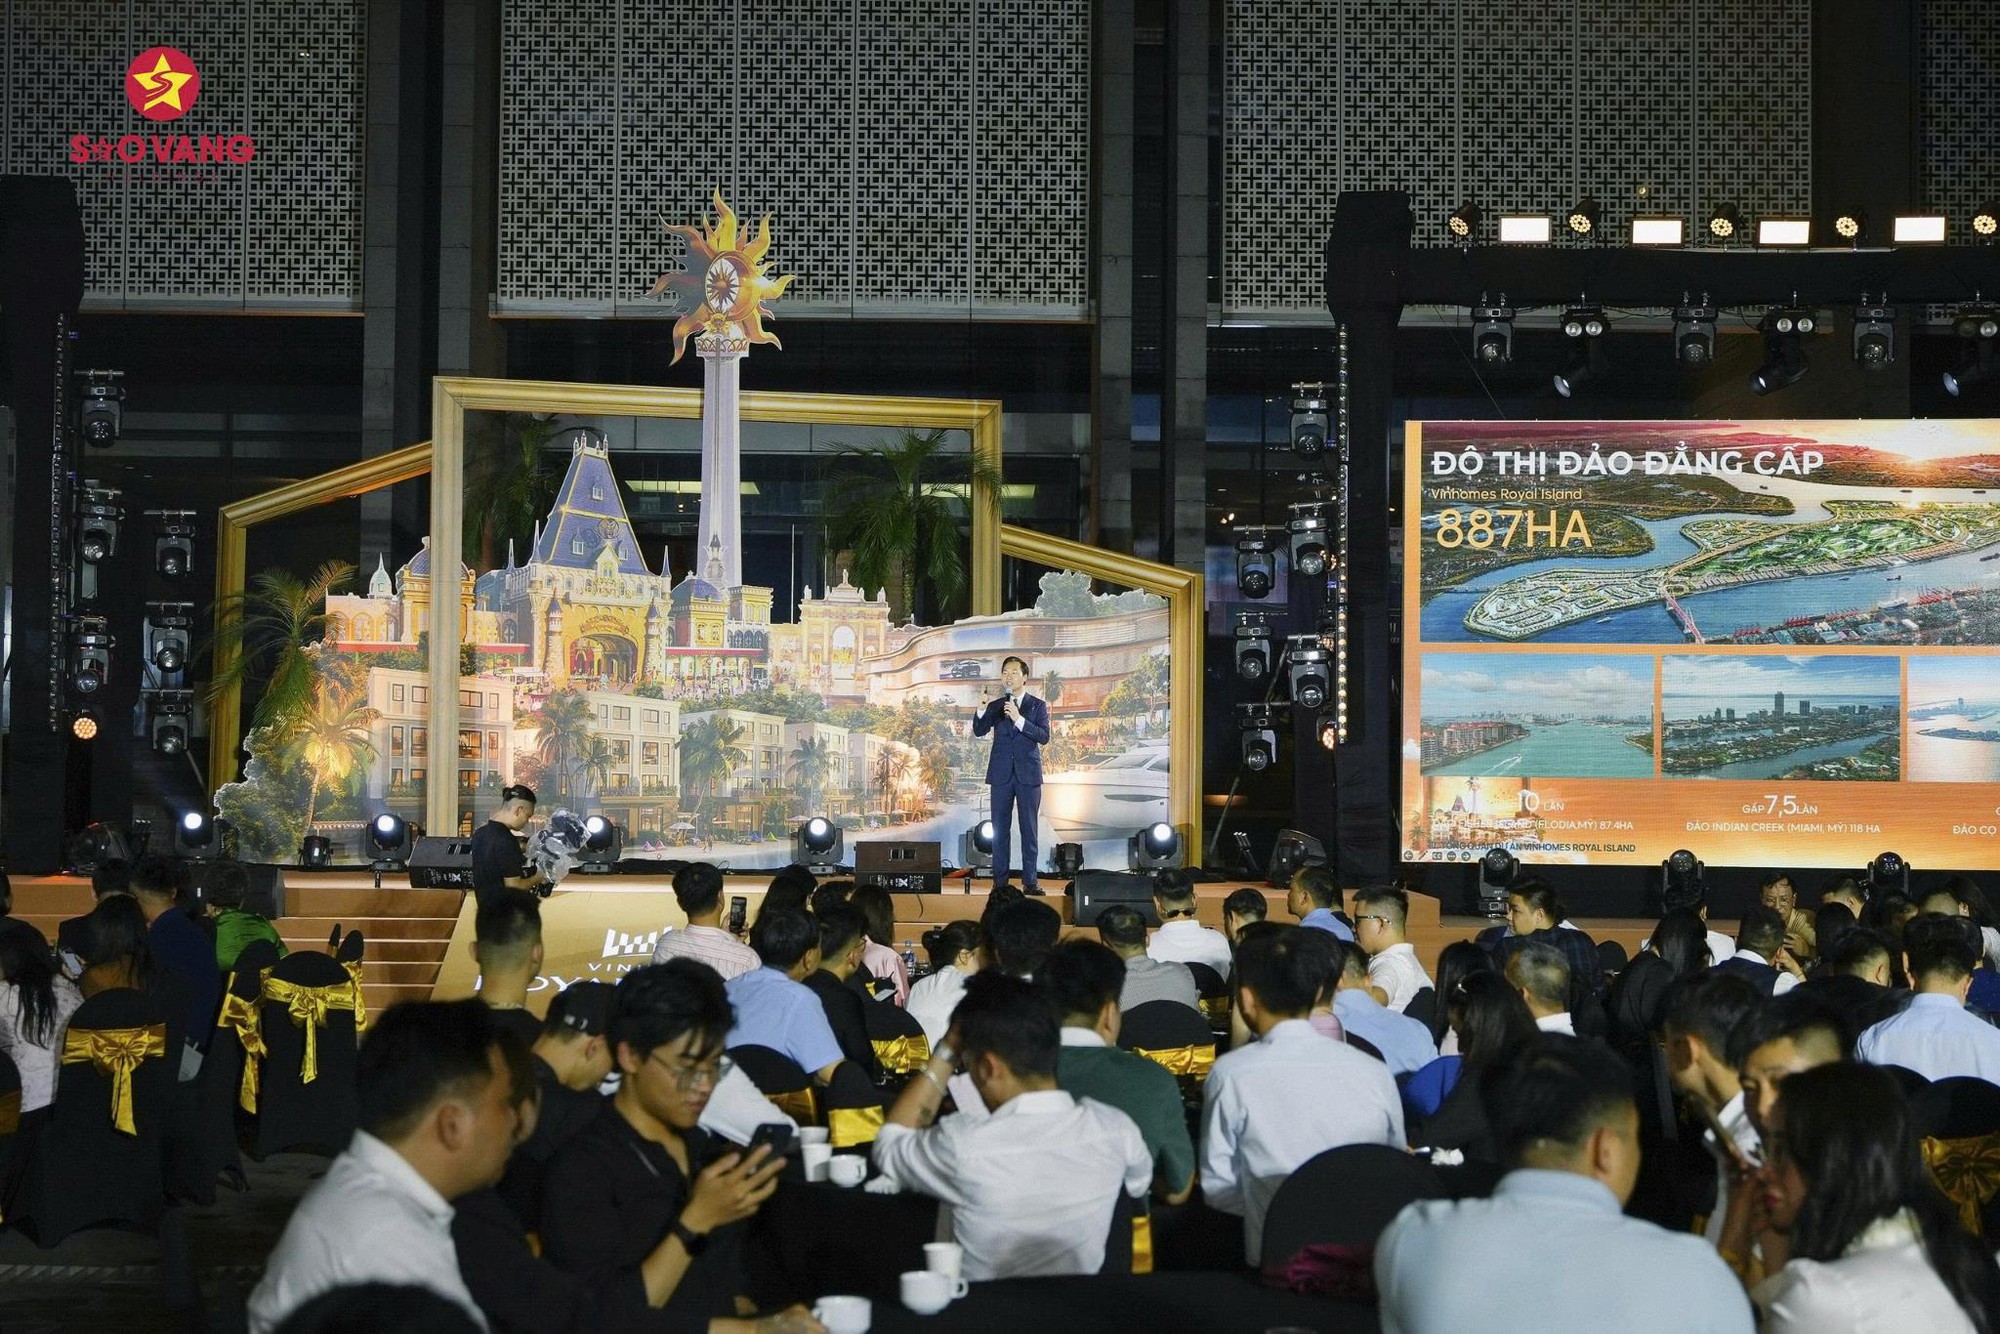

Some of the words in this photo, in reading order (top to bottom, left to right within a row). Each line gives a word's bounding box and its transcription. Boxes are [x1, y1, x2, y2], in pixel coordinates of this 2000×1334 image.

[1430, 444, 1484, 475] ĐÔ
[1492, 450, 1547, 482] THỊ
[1555, 442, 1634, 476] ĐẢO
[1642, 440, 1743, 476] ĐẲNG
[1753, 442, 1825, 476] CẤP
[1430, 487, 1497, 500] Vinhomes
[1500, 487, 1538, 503] Royal
[1541, 487, 1582, 500] Island
[1436, 507, 1593, 549] 887HA
[1517, 789, 1540, 812] 10
[1764, 794, 1797, 818] 7,5
[1712, 821, 1749, 832] INDIAN
[1751, 822, 1785, 833] CREEK
[1865, 823, 1881, 834] HA
[1524, 843, 1571, 852] VINHOMES
[1572, 843, 1602, 852] ROYAL
[1603, 844, 1636, 853] ISLAND
